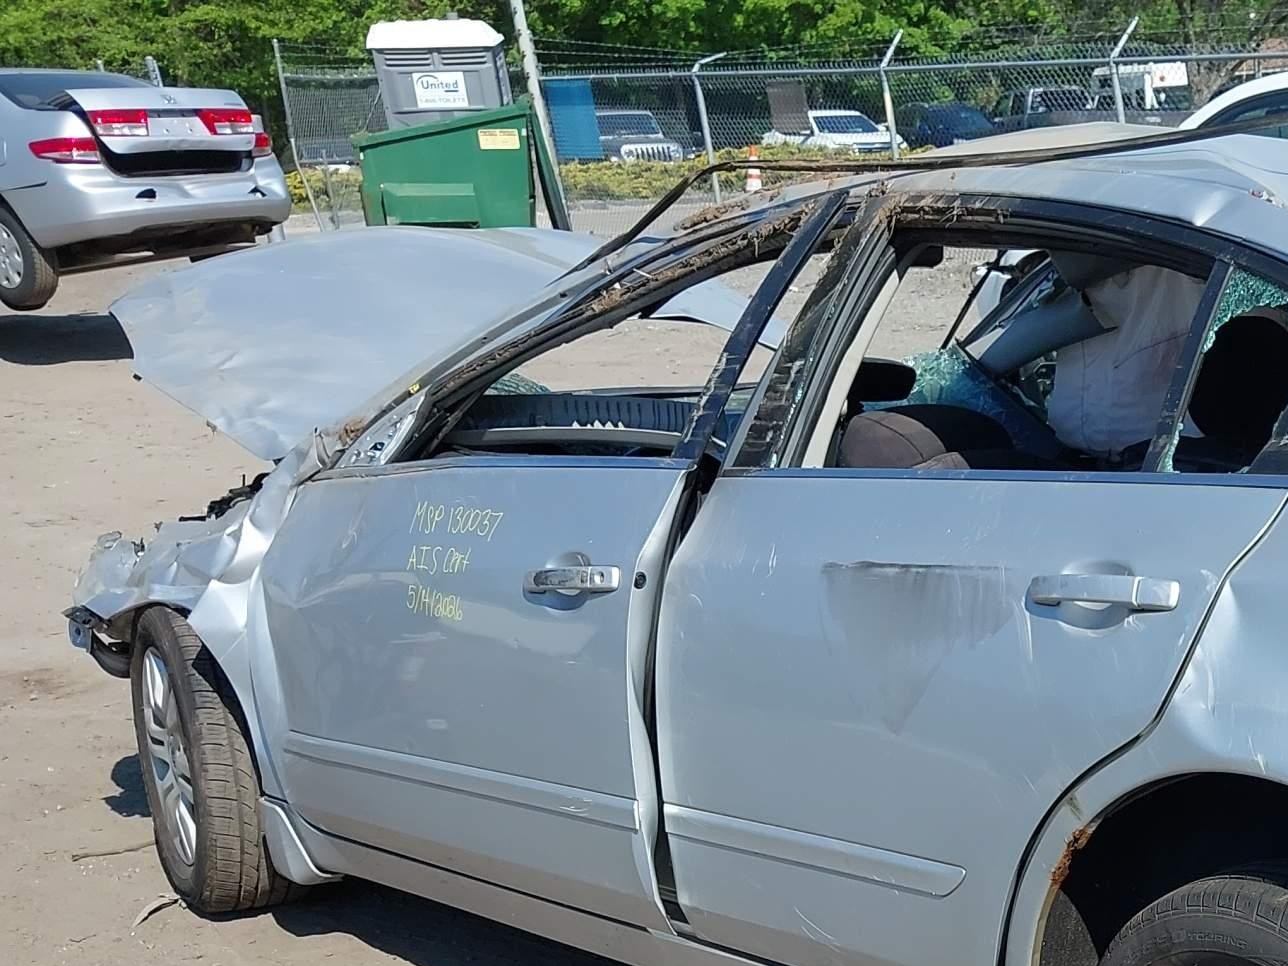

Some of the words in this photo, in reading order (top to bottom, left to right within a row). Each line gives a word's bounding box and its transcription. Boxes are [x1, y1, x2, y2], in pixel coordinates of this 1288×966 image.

[421, 79, 459, 90] United
[447, 506, 504, 542] 130037
[406, 545, 442, 575] AIS
